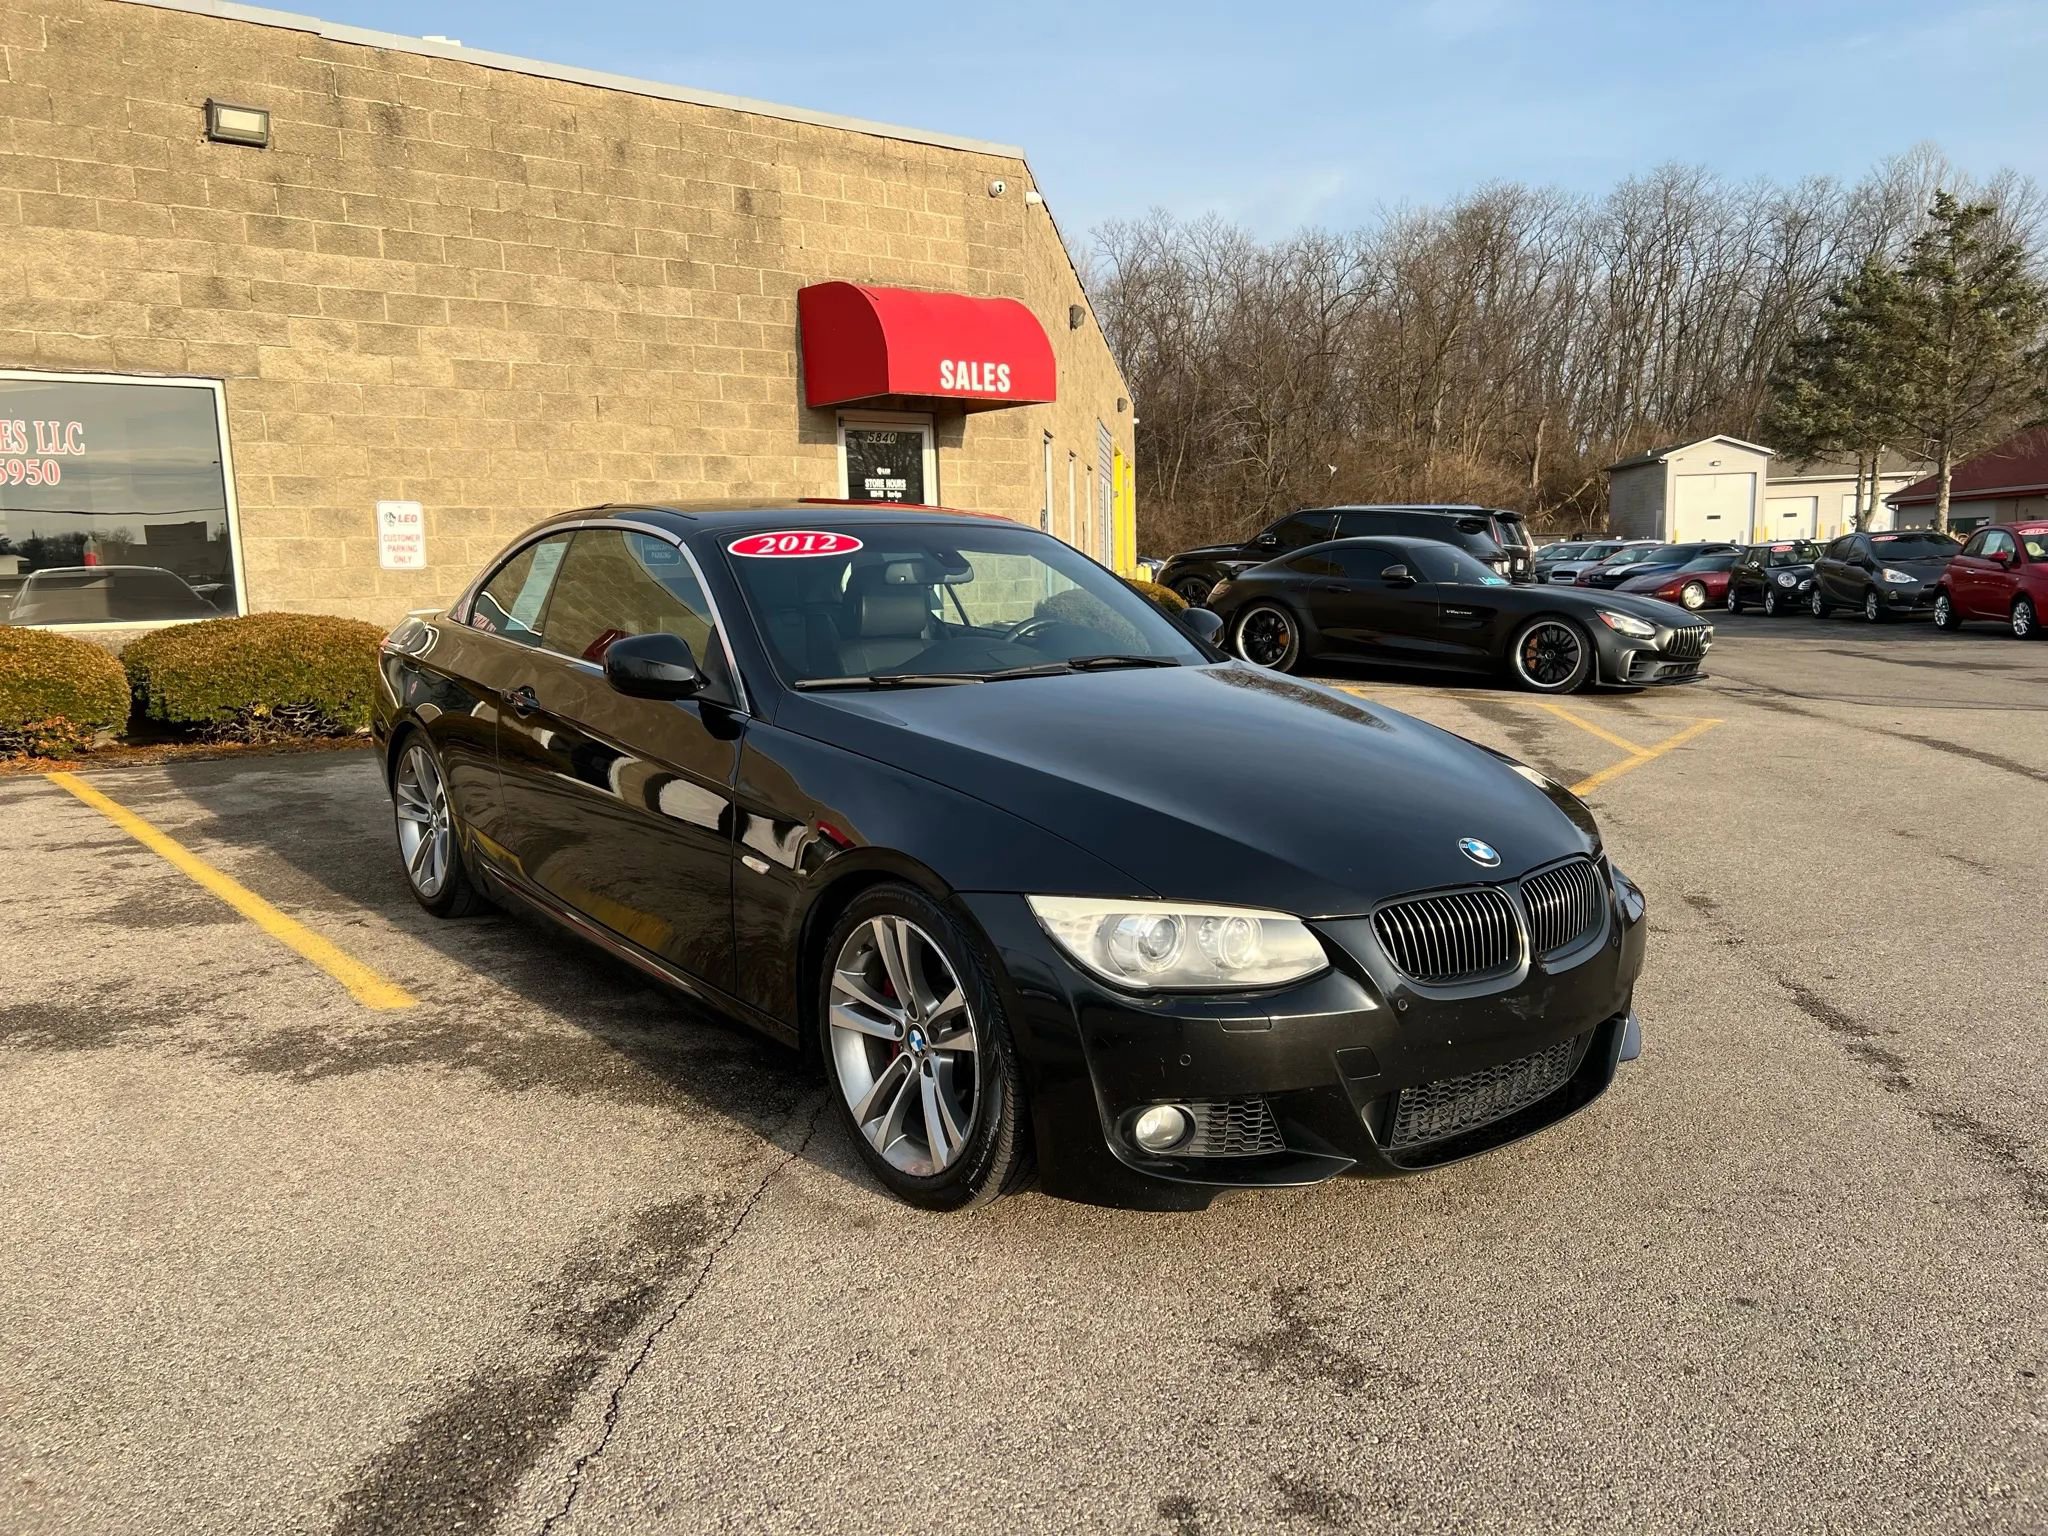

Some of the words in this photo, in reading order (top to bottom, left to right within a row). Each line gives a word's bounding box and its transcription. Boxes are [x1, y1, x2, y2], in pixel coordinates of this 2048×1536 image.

[940, 359, 1011, 393] SALES
[33, 420, 86, 456] LLC
[869, 431, 896, 443] 5840
[865, 479, 884, 488] STORE
[886, 479, 906, 488] HOURS
[398, 514, 418, 523] LEO
[383, 534, 421, 542] CUSTOMER
[387, 544, 418, 553] PARKING
[755, 535, 838, 554] 2012
[393, 555, 412, 564] ONLY
